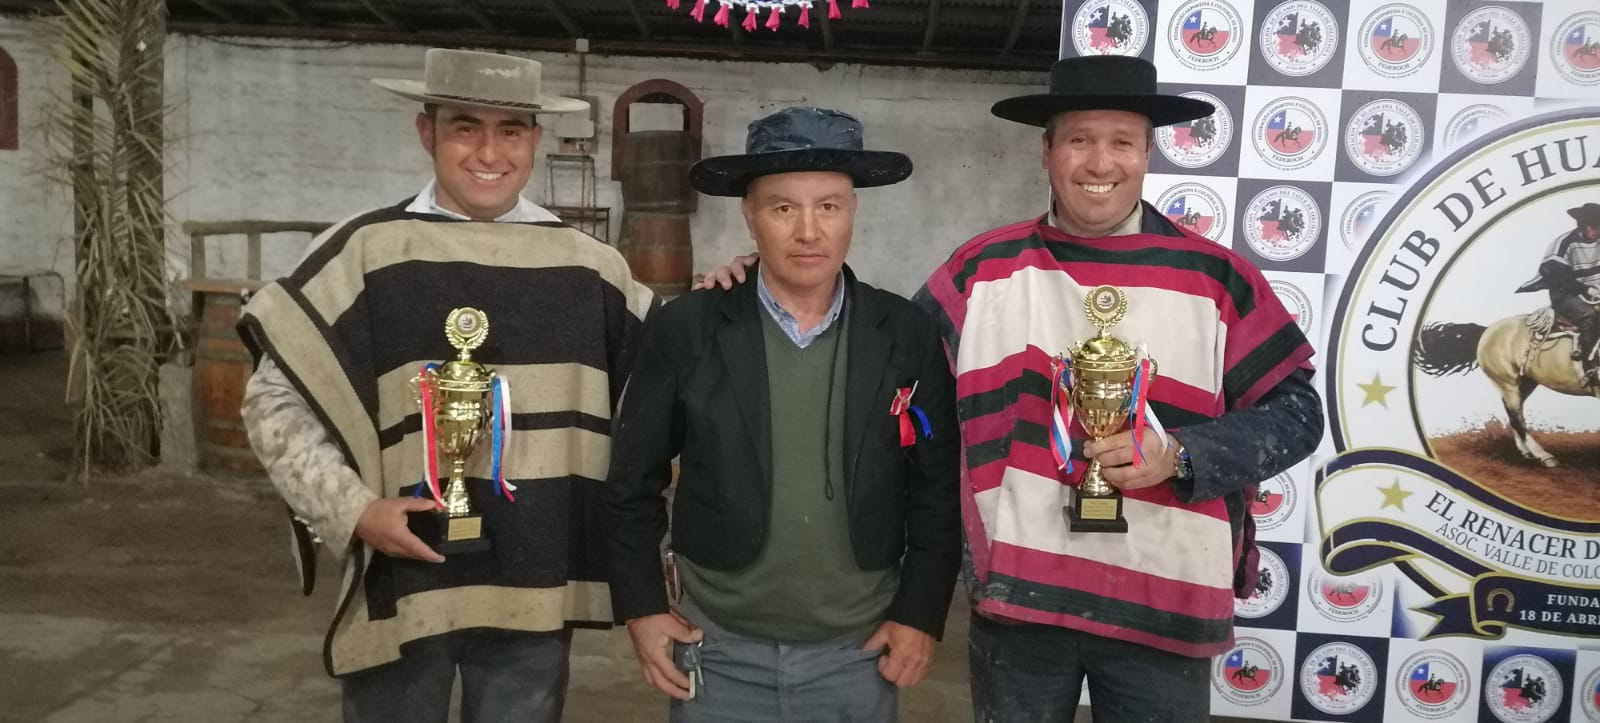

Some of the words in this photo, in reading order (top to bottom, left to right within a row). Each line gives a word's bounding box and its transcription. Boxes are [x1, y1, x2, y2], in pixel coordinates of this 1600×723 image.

[1361, 230, 1441, 352] CLUB
[1433, 168, 1507, 232] DE
[1511, 135, 1600, 187] HU
[1425, 490, 1456, 521] EL
[1458, 508, 1577, 559] RENACER
[1436, 523, 1477, 553] ASOC.
[1484, 545, 1533, 571] VALLE
[1535, 559, 1558, 576] DE
[1519, 610, 1536, 621] 18
[1541, 611, 1562, 622] DE
